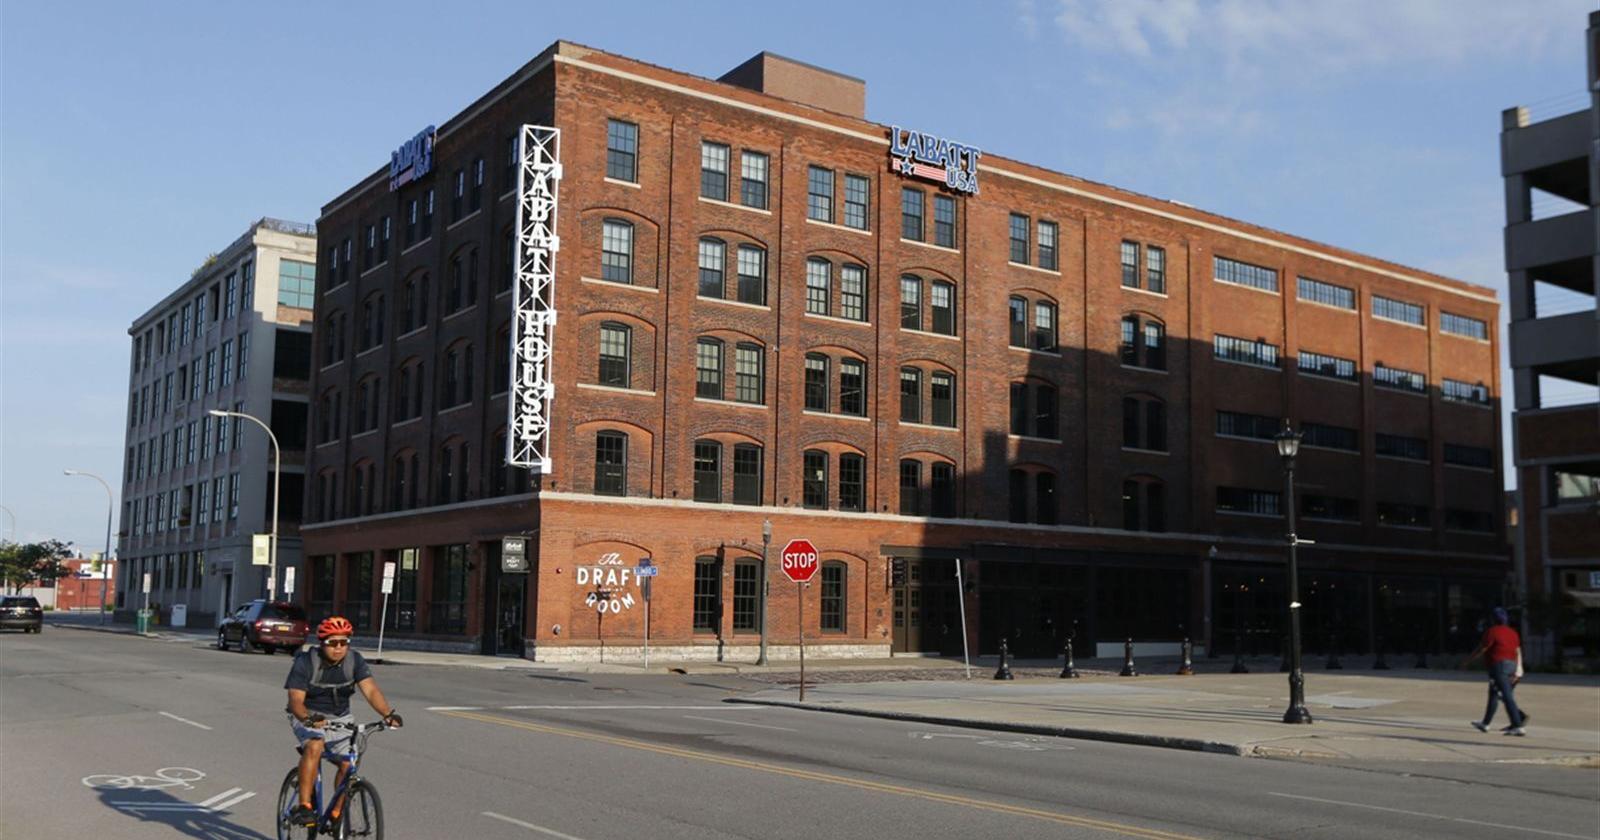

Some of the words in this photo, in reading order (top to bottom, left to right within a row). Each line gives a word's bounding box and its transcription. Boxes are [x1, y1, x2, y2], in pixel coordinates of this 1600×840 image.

[890, 125, 981, 173] LABATT
[946, 166, 980, 194] USA
[525, 146, 551, 298] LABATT
[520, 310, 547, 440] HOUSE
[598, 552, 624, 566] The
[784, 552, 816, 569] STOP
[585, 593, 635, 613] ROOM
